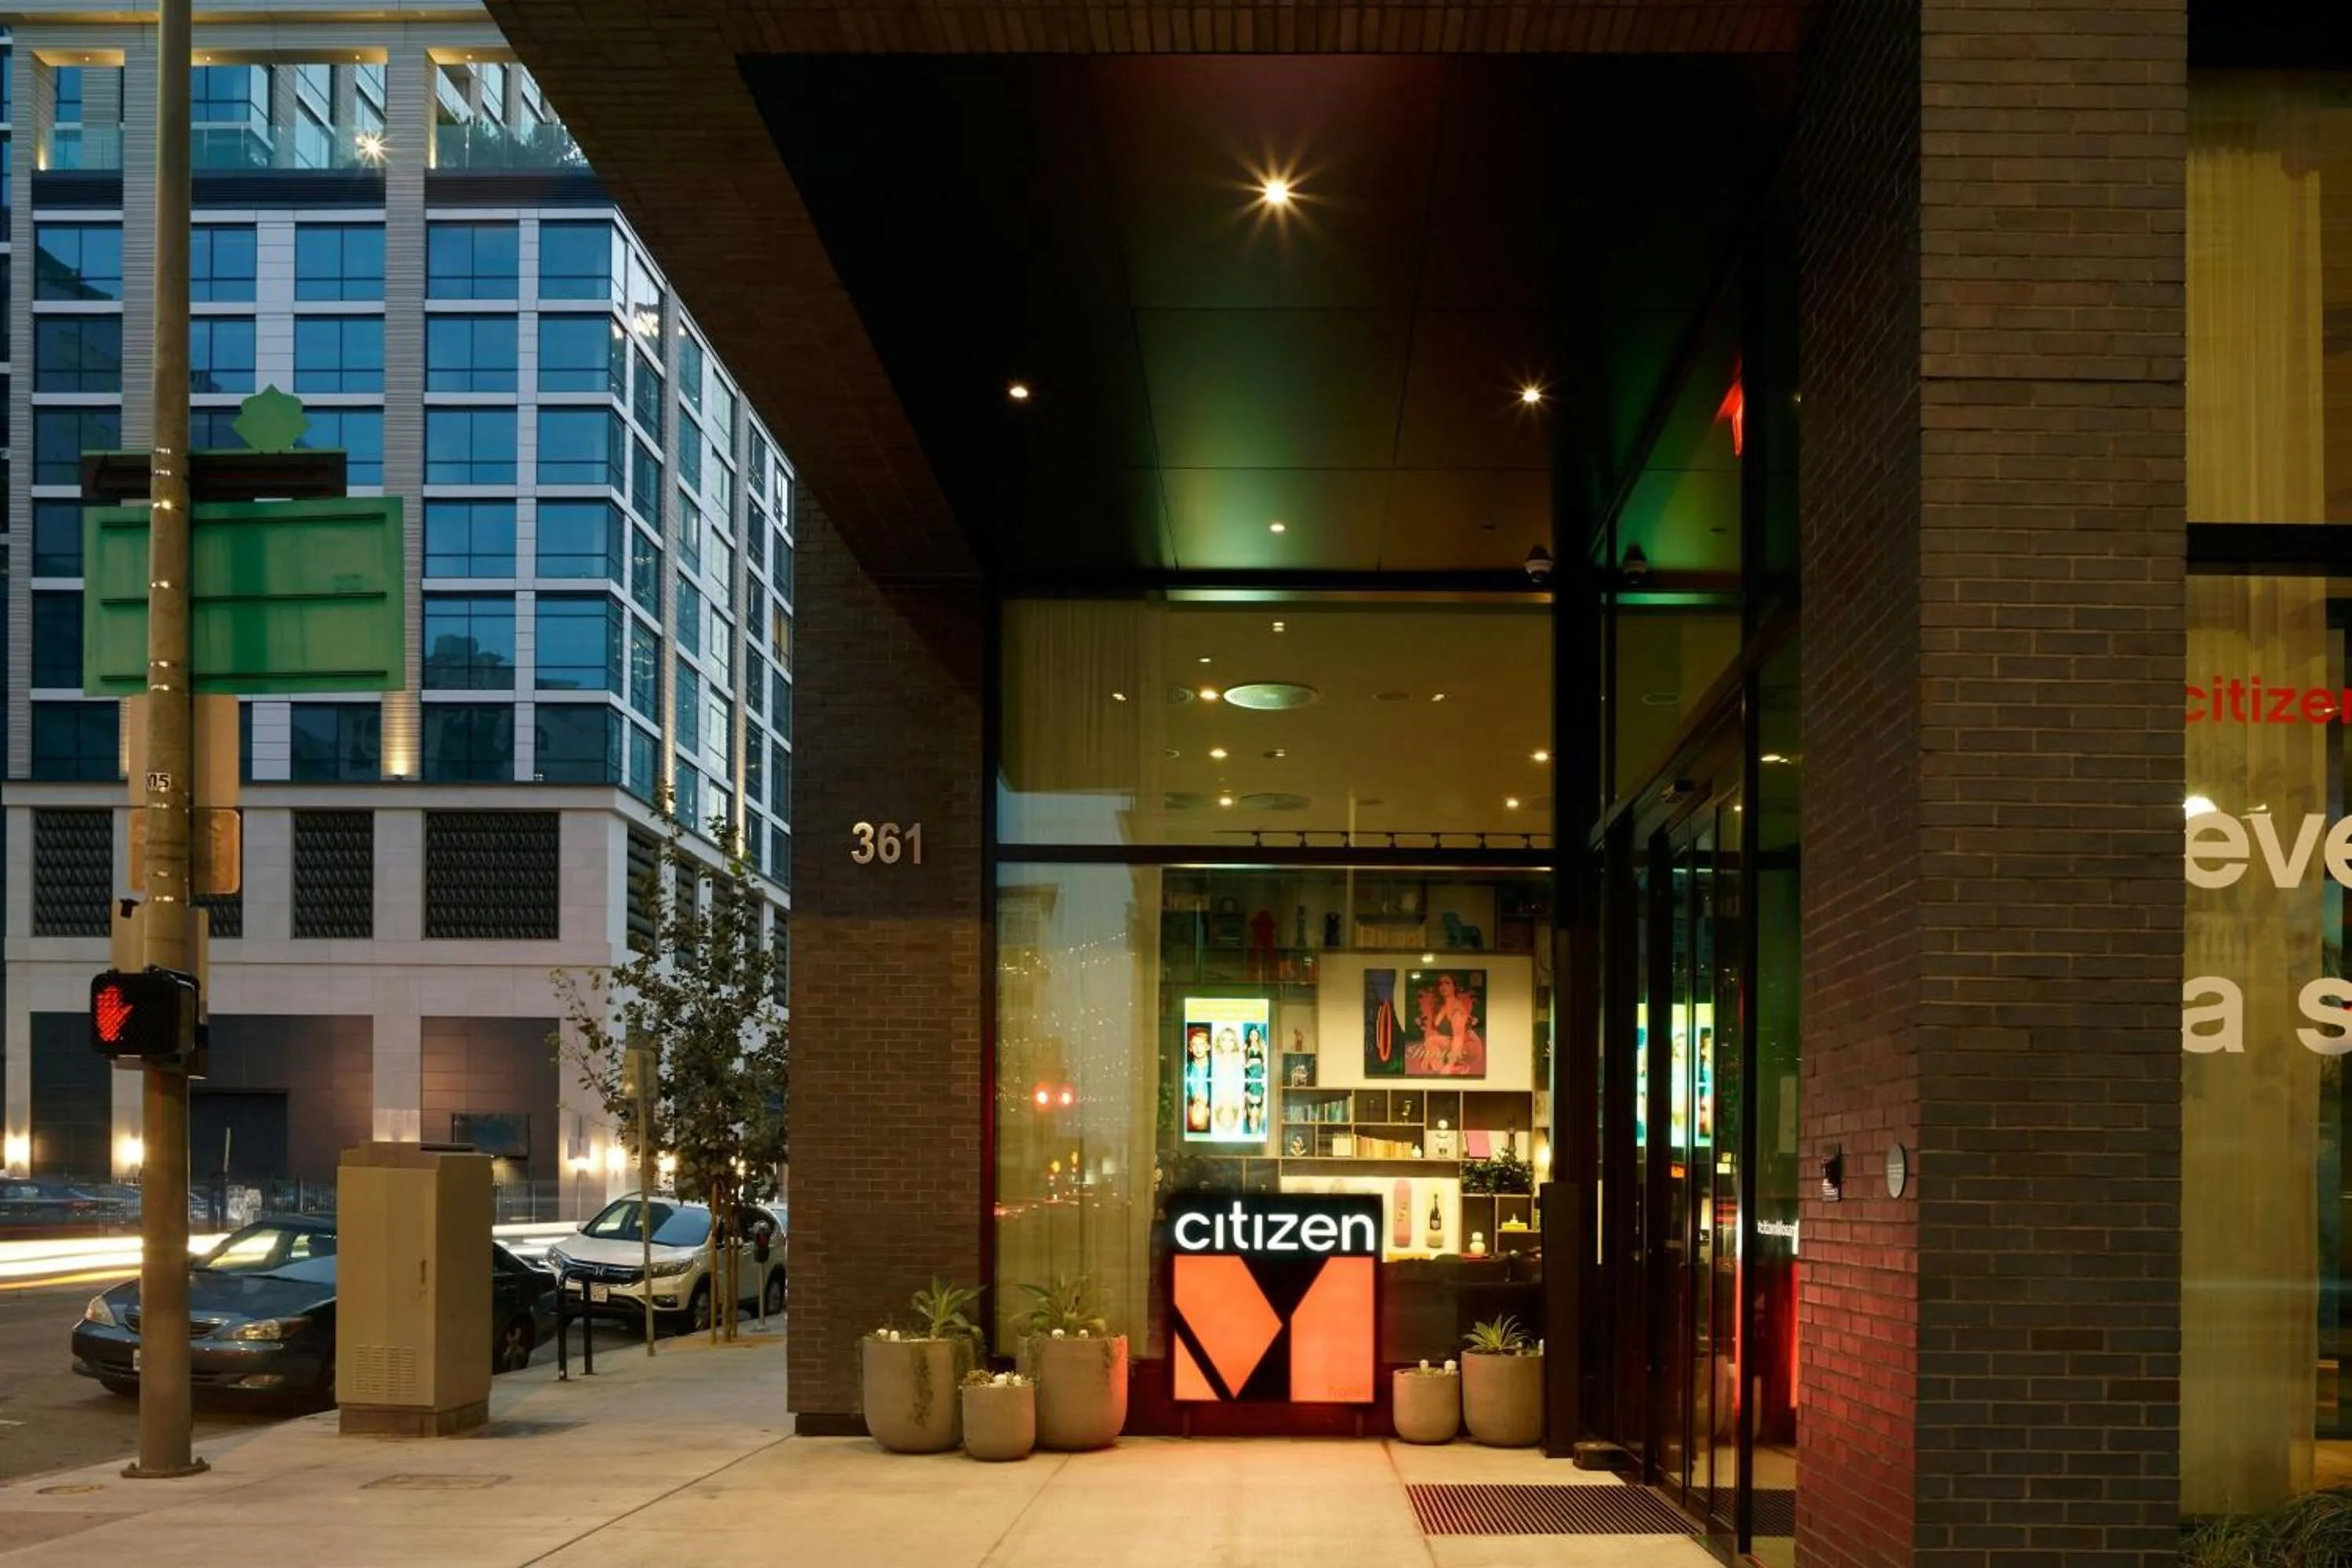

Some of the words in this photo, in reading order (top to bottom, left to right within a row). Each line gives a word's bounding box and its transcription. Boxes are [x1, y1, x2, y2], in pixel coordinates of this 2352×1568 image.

[851, 822, 922, 865] 361
[2182, 975, 2245, 1054] a
[1174, 1200, 1375, 1252] citizen
